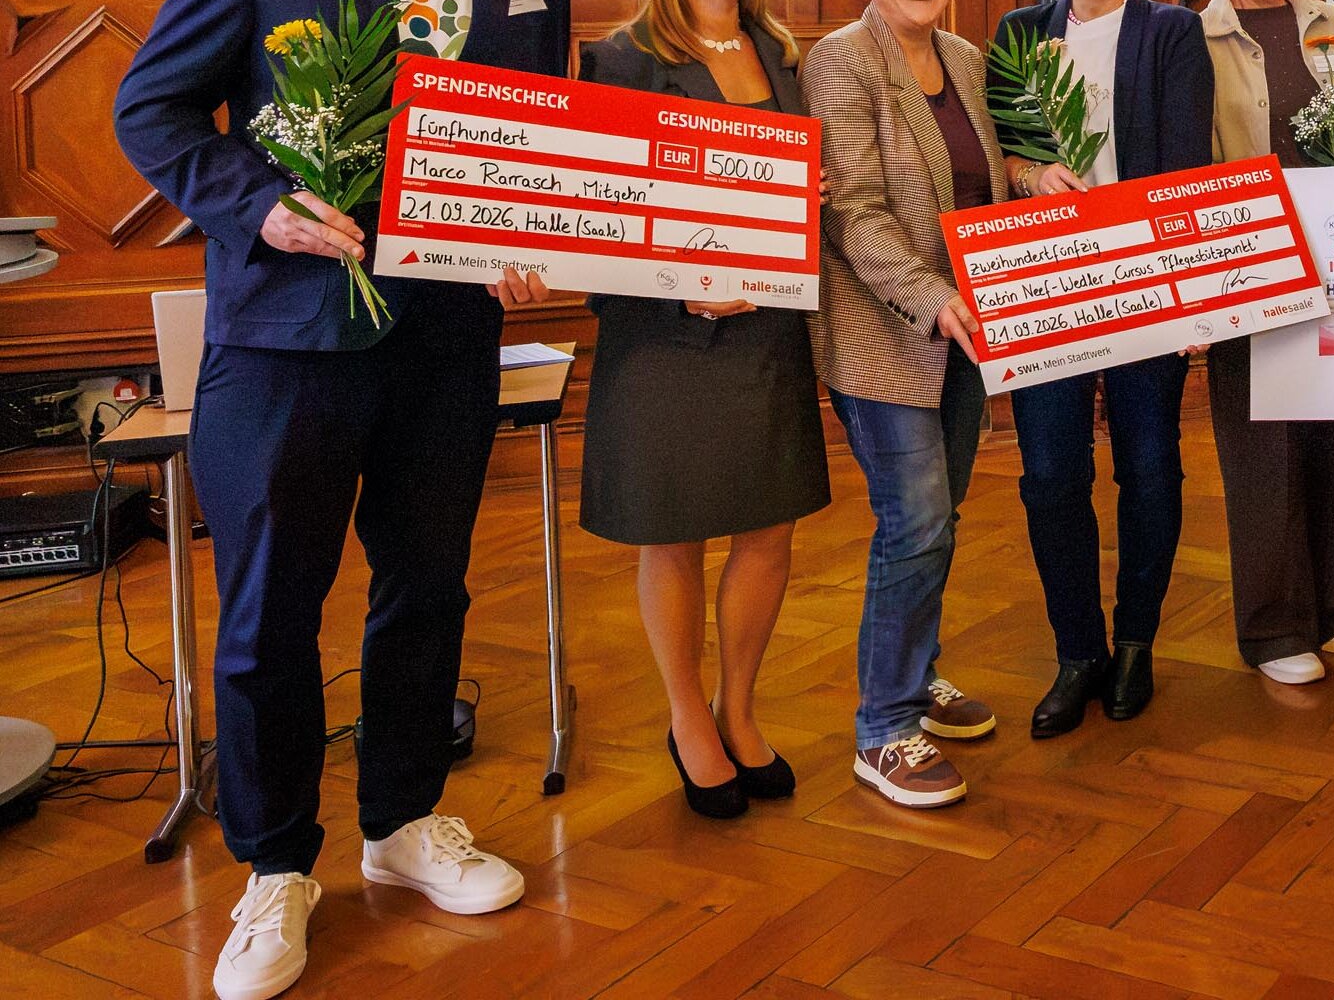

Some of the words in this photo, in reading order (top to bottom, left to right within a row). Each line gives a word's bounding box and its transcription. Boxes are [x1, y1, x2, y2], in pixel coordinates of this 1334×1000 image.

[412, 72, 569, 110] SPENDENSCHECK
[658, 110, 808, 145] GESUNDHEITSPREIS
[410, 157, 466, 180] Marco
[664, 150, 690, 165] EUR
[709, 154, 774, 181] 500,00
[1147, 169, 1273, 202] GESUNDHEITSPREIS
[526, 211, 571, 234] Halle
[576, 214, 626, 243] (Saale)
[956, 205, 1078, 239] SPENDENSCHECK
[1163, 219, 1187, 233] EUR
[423, 253, 456, 266] SWH.
[459, 256, 487, 268] Mein
[491, 258, 548, 274] Stadtwerk
[742, 279, 802, 295] hallesaale
[976, 290, 1018, 309] Katrin
[1075, 306, 1113, 326] Halle
[1115, 290, 1162, 319] (Saale)
[1263, 299, 1314, 318] hallesaale
[1017, 363, 1042, 375] SWH.
[1044, 358, 1065, 369] Mein
[1069, 347, 1112, 364] Stadtwerk
